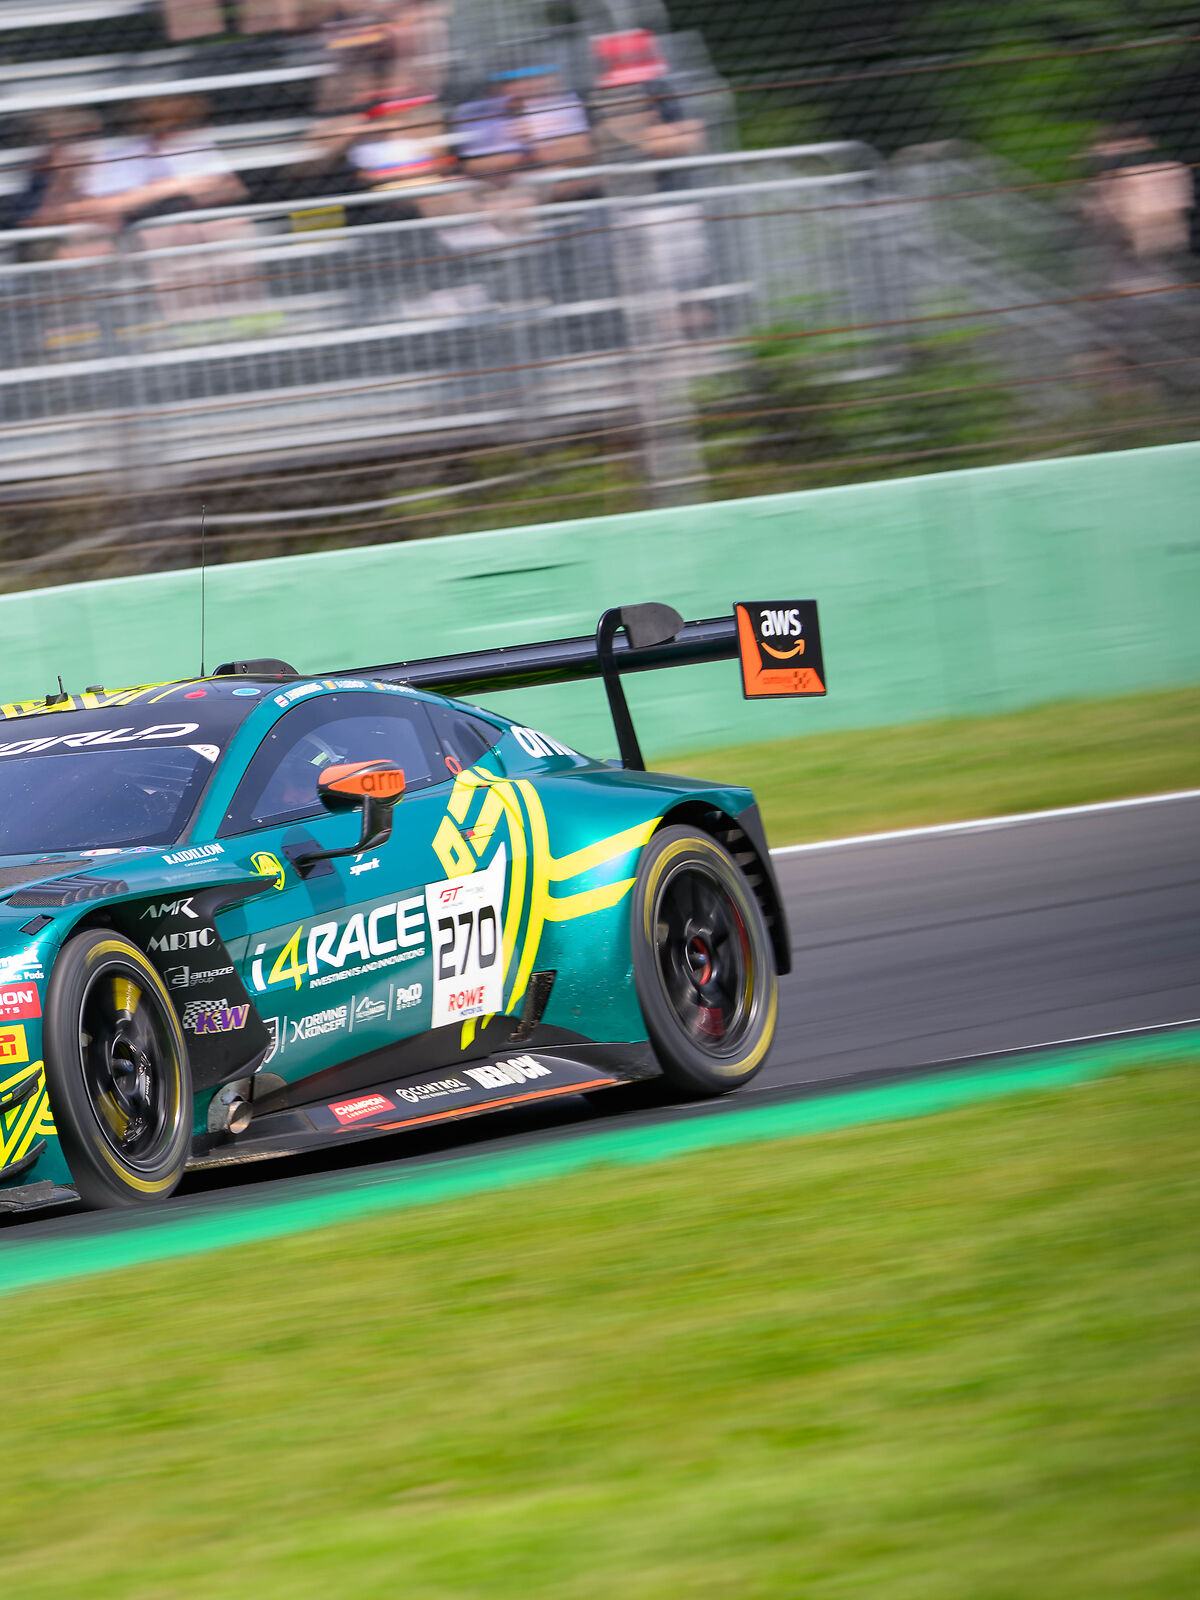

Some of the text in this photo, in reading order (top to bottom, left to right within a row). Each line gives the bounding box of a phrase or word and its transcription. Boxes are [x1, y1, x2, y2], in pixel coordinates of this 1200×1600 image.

[760, 609, 802, 637] aws
[360, 770, 405, 792] arm
[161, 843, 225, 865] RAIDILLON
[440, 886, 463, 903] GT
[139, 897, 199, 920] AMR
[146, 927, 216, 953] MRTC
[251, 895, 426, 992] i4RACE
[438, 905, 497, 981] 270
[190, 966, 234, 980] amaze
[190, 977, 215, 986] group
[448, 986, 485, 1012] ROWE
[193, 1003, 250, 1034] KW
[305, 1006, 347, 1027] DRIVING
[304, 1018, 347, 1039] KONCEPT
[411, 1079, 467, 1095] CONTROL
[334, 1097, 386, 1116] CHAMPION
